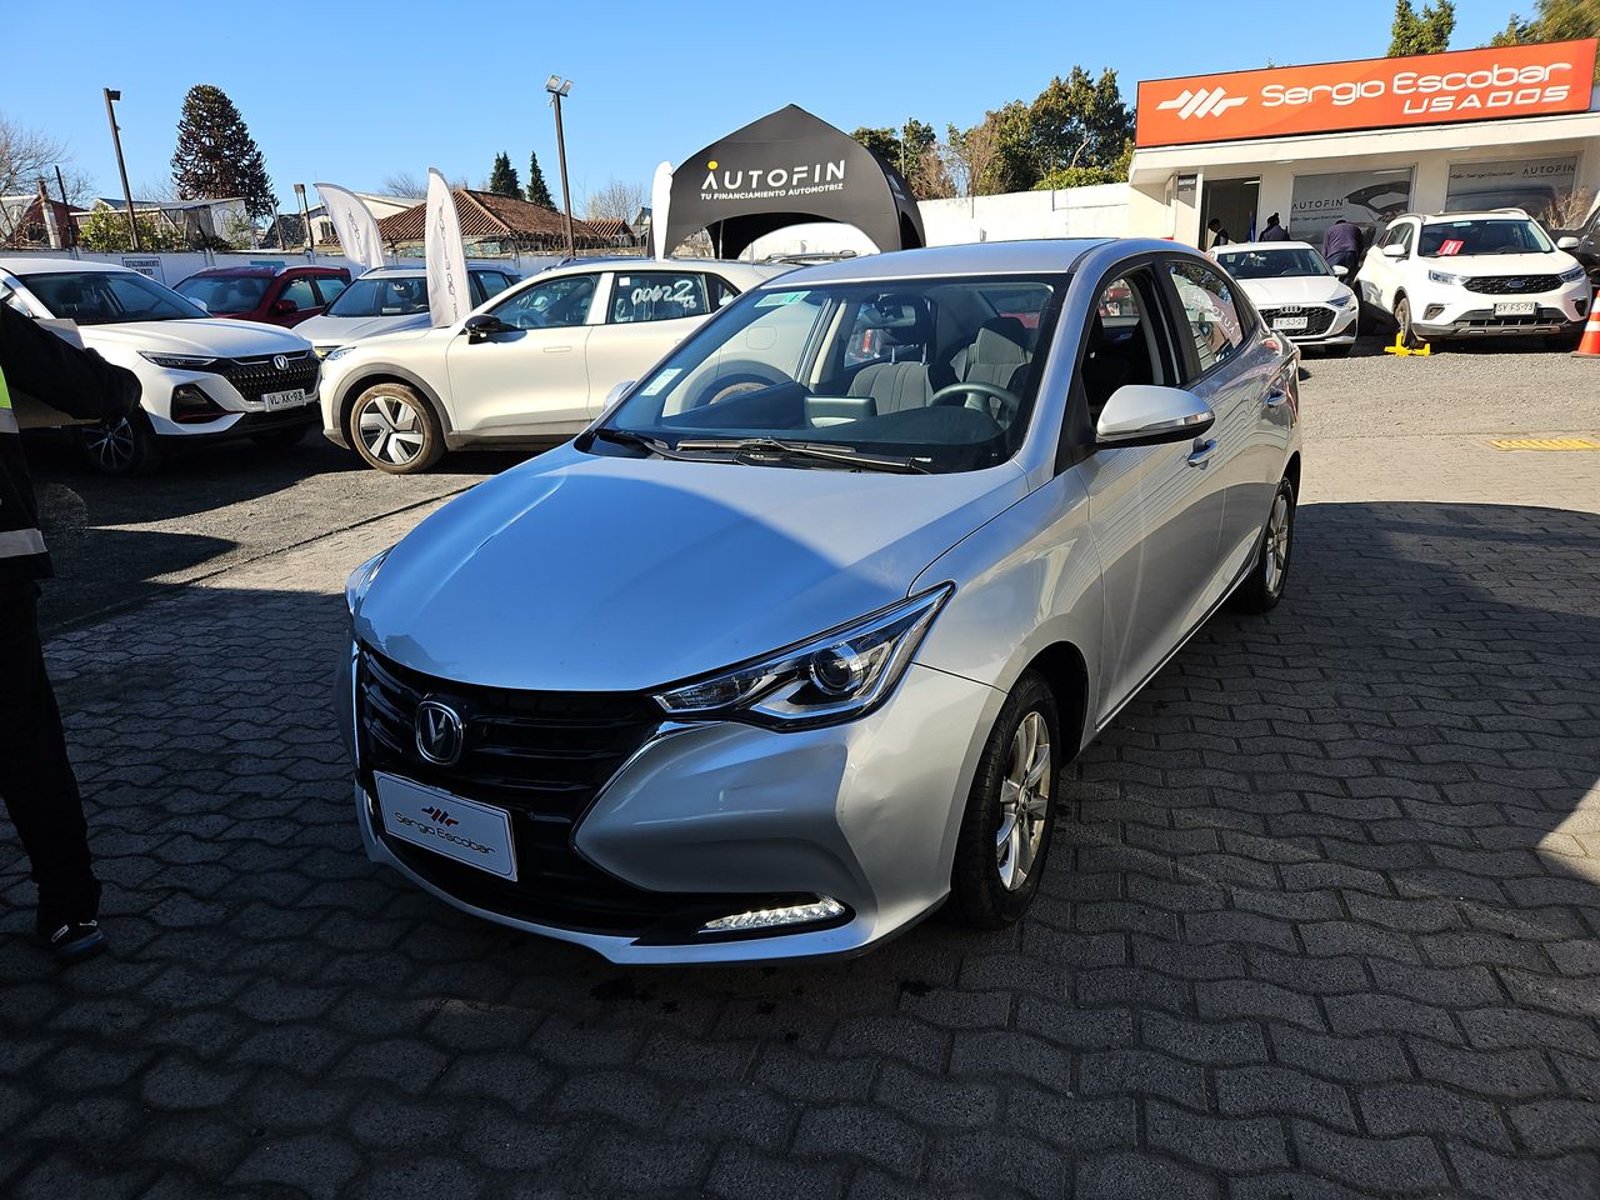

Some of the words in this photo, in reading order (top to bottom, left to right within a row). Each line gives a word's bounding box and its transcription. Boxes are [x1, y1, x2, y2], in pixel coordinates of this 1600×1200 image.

[1261, 80, 1386, 107] Sergio
[1392, 62, 1573, 95] Escobar
[1403, 84, 1571, 115] USADOS
[701, 160, 846, 190] AUTOFIN
[1523, 164, 1576, 175] AUTOFIN
[713, 190, 786, 200] FINANCIAMIENTO
[788, 183, 844, 196] AUTOMOTRIZ
[1291, 198, 1344, 210] AUTOFIN
[395, 812, 435, 835] Sergio
[437, 828, 496, 854] Escobar
